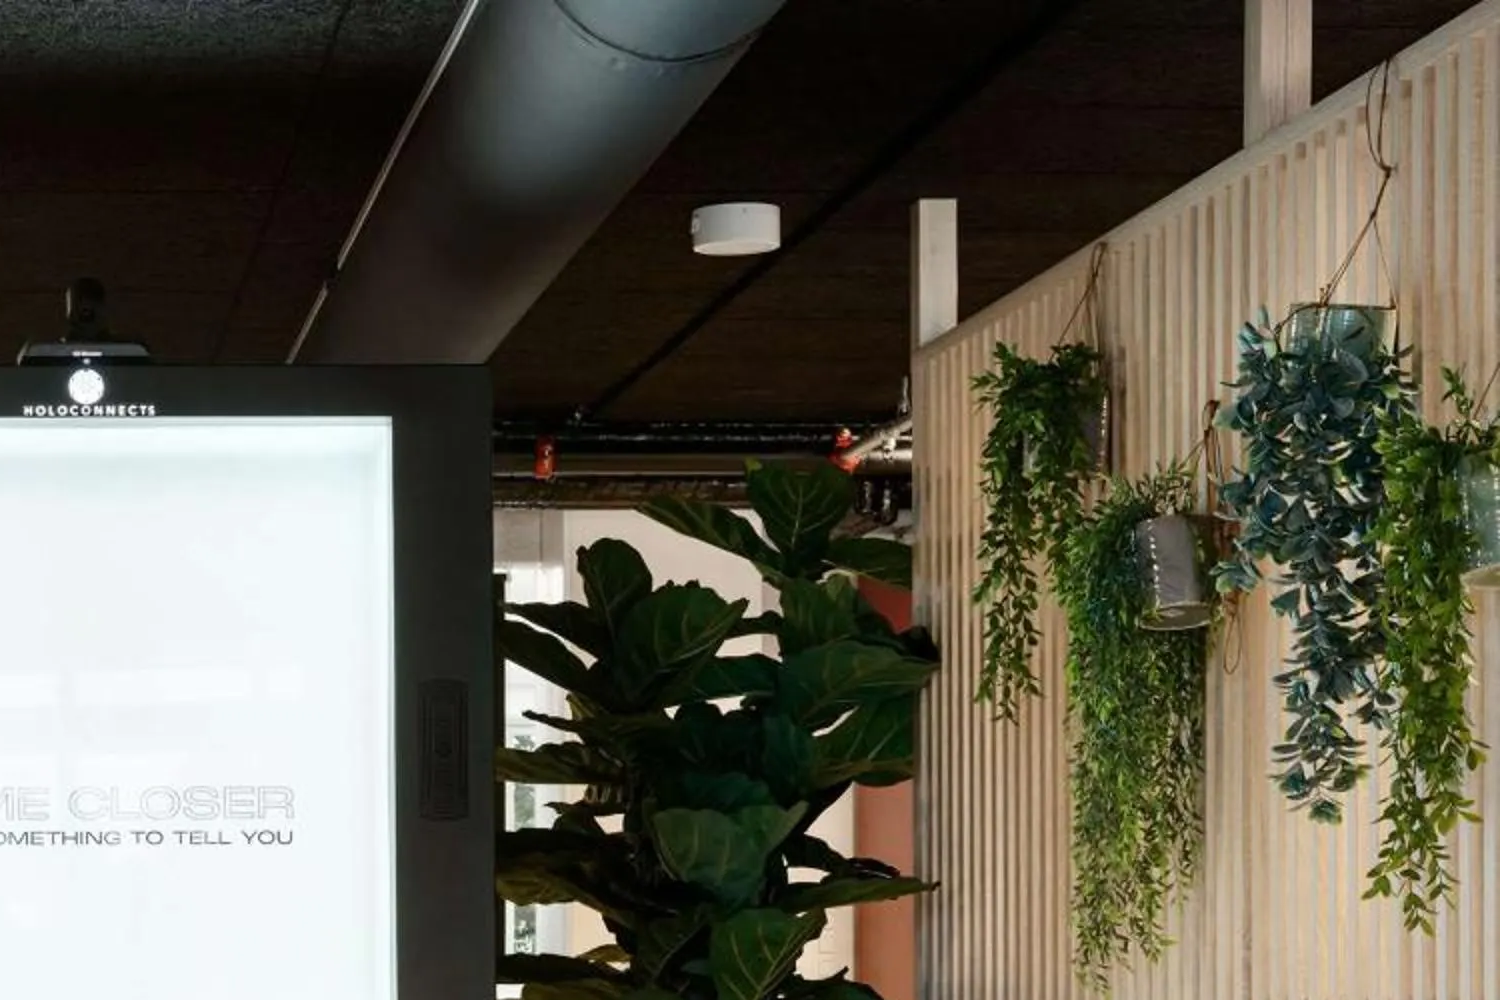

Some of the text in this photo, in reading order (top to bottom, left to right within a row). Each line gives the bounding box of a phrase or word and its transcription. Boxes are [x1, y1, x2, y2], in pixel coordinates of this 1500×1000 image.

[22, 404, 157, 416] HOLOCONNECTS
[67, 785, 296, 821] CLOSER
[130, 830, 165, 845] TO
[172, 830, 233, 845] TELL
[240, 829, 294, 845] YOU
